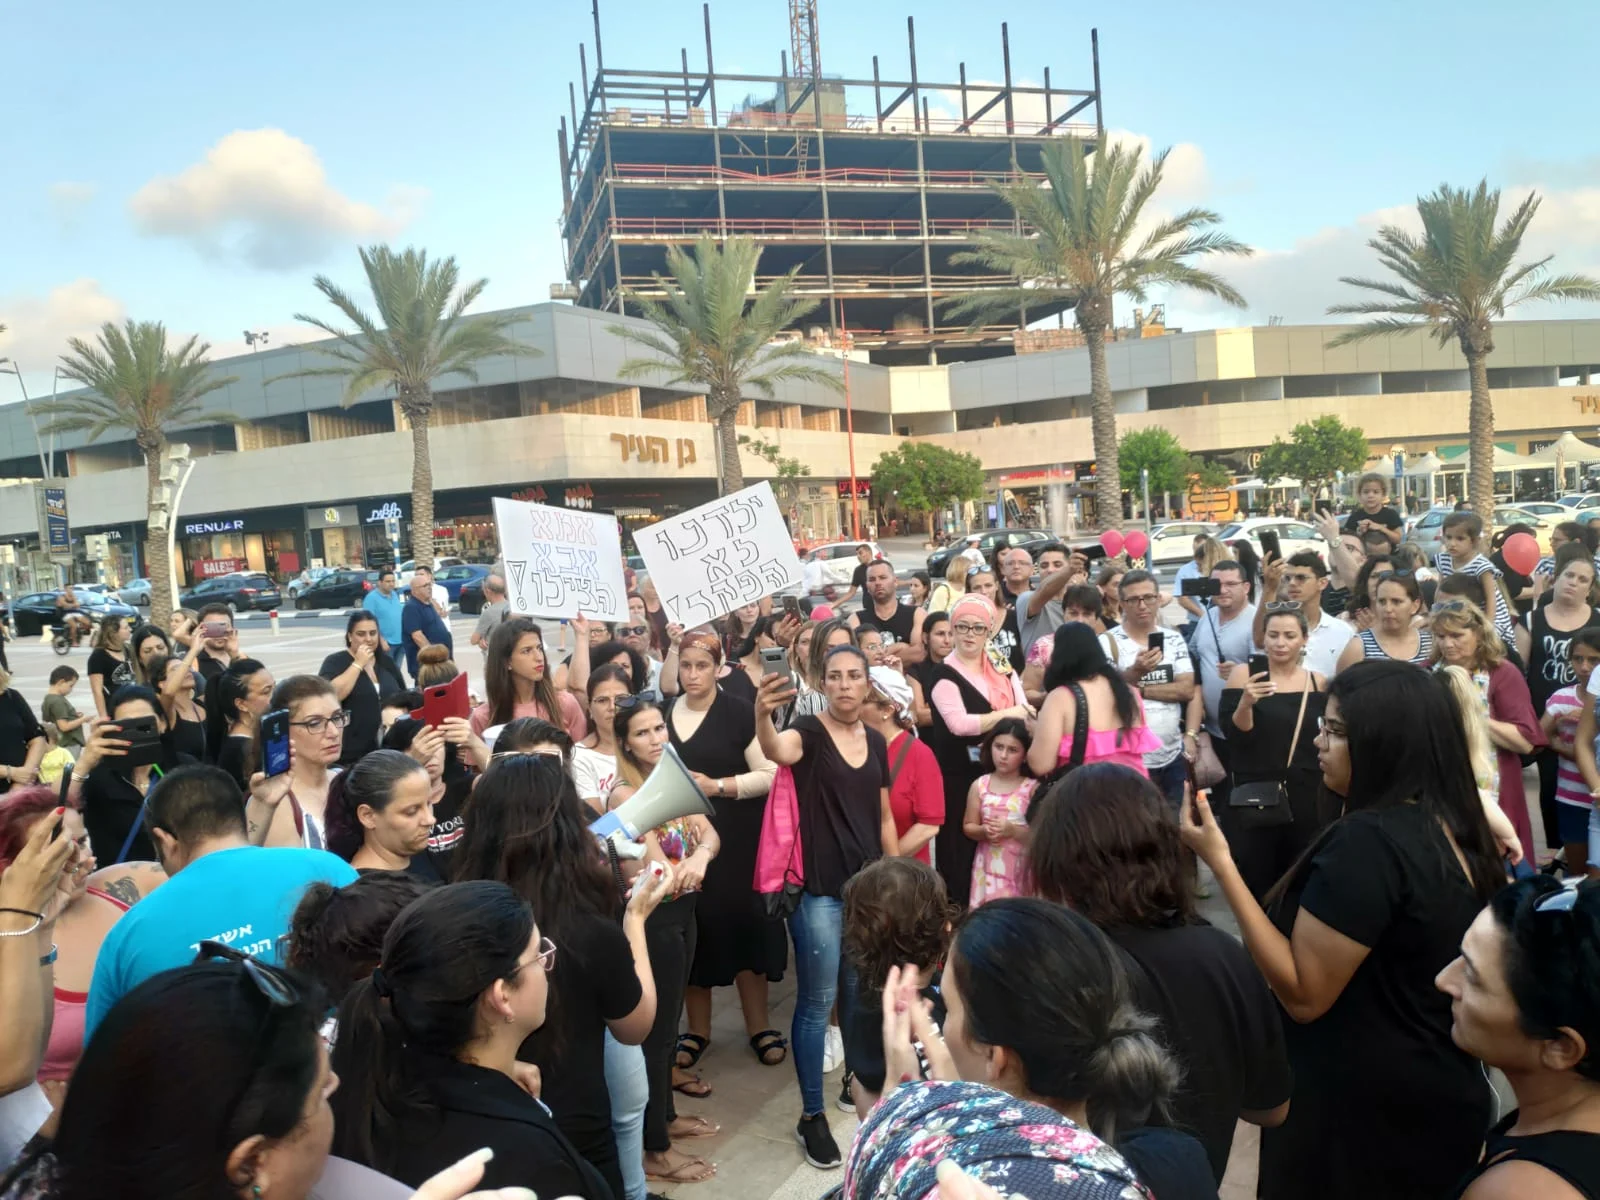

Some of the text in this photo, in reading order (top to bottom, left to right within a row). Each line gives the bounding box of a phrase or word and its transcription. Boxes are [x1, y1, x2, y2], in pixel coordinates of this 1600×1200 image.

[610, 432, 696, 469] גן העיר
[185, 519, 244, 534] RENUAR
[530, 509, 597, 546] אמא
[655, 495, 763, 561] ילדנו
[203, 561, 225, 575] SALE
[531, 543, 600, 581] אבא
[700, 538, 760, 583] לא
[506, 560, 617, 615] הצילו!
